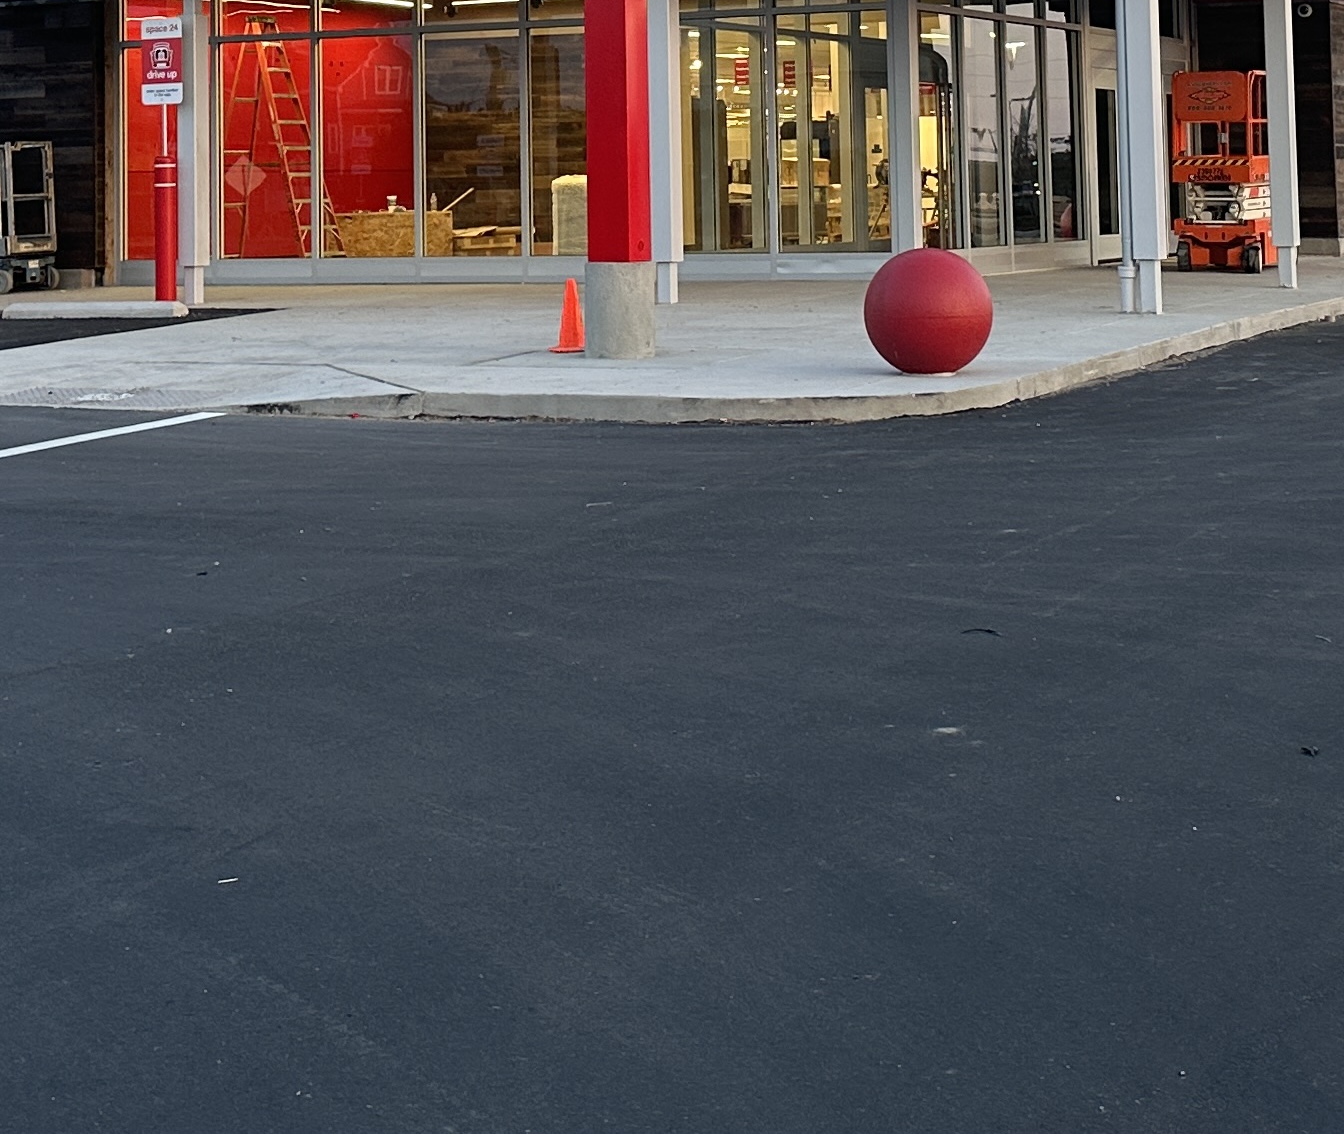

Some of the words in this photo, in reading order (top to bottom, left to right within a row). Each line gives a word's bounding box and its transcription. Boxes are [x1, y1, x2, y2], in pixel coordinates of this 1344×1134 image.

[146, 26, 168, 34] space
[146, 70, 165, 79] drive
[167, 70, 177, 80] up
